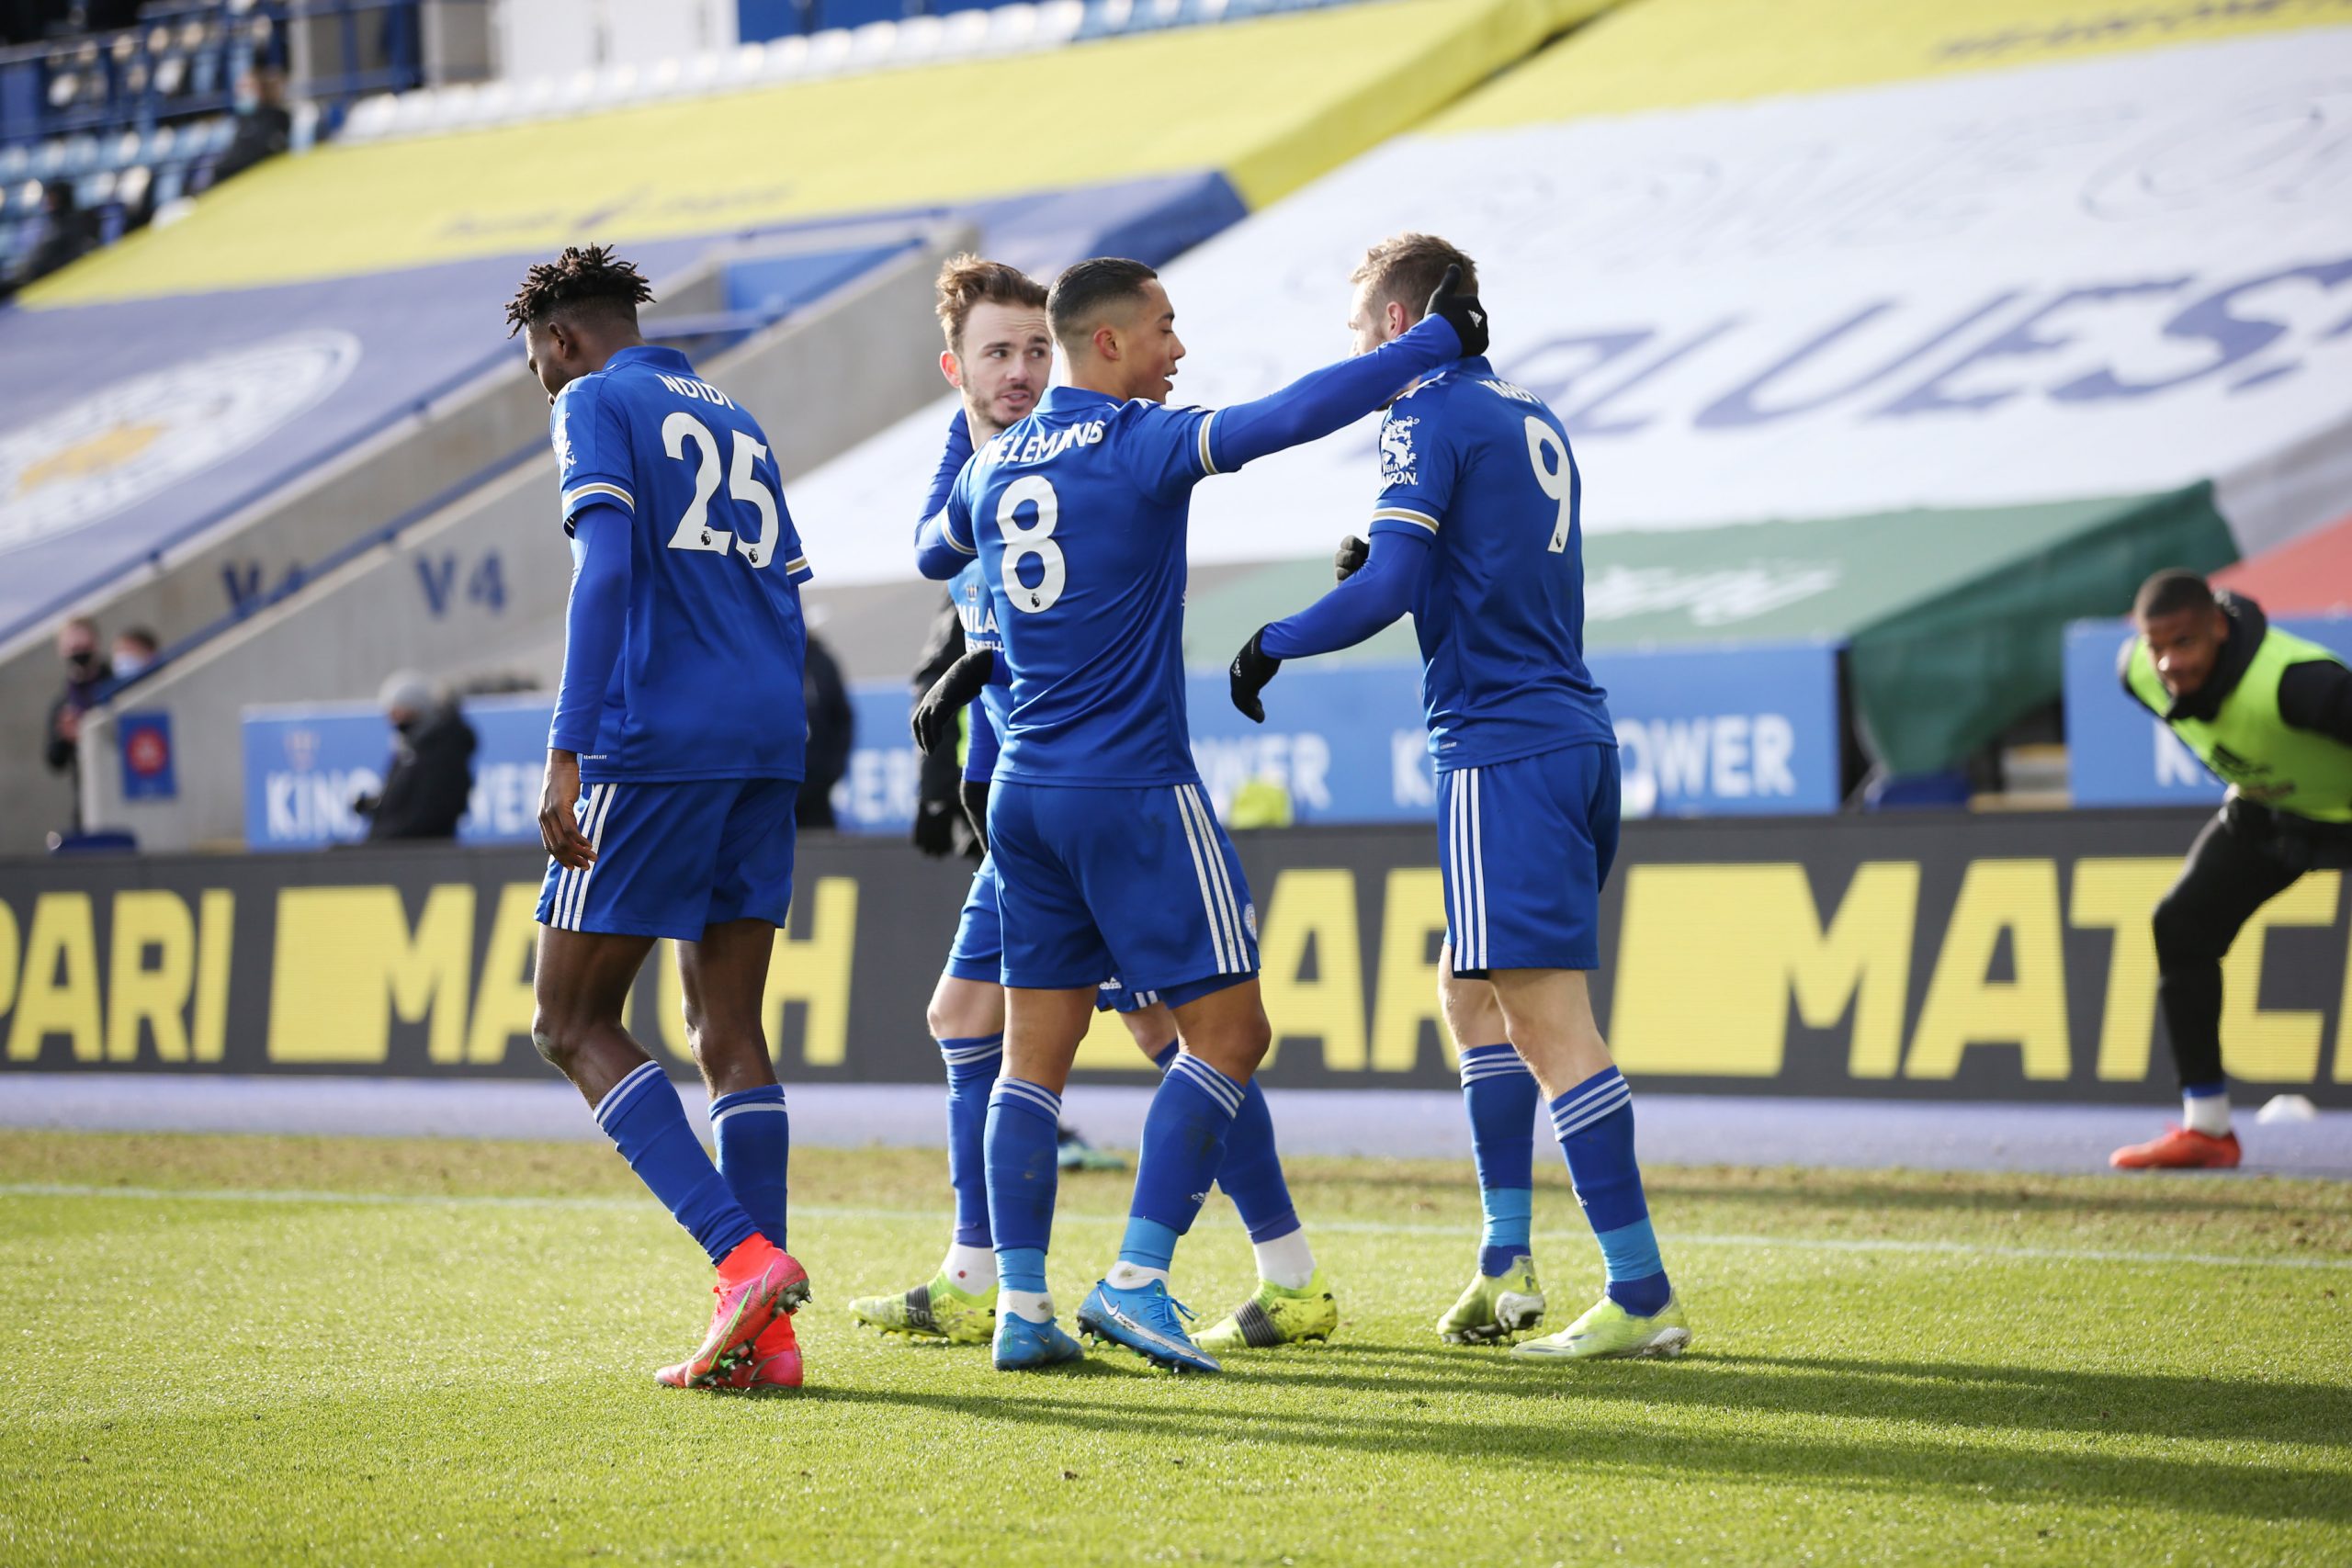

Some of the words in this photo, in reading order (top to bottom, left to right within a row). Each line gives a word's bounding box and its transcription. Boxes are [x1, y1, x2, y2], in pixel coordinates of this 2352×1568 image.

[655, 373, 735, 411] NDIDI
[662, 412, 779, 569] 25
[996, 475, 1066, 614] 8
[1523, 415, 1572, 554] 9
[415, 550, 509, 616] V4
[1611, 714, 1796, 797] OWER
[266, 876, 859, 1066] MAH
[1606, 856, 2352, 1086] MATC
